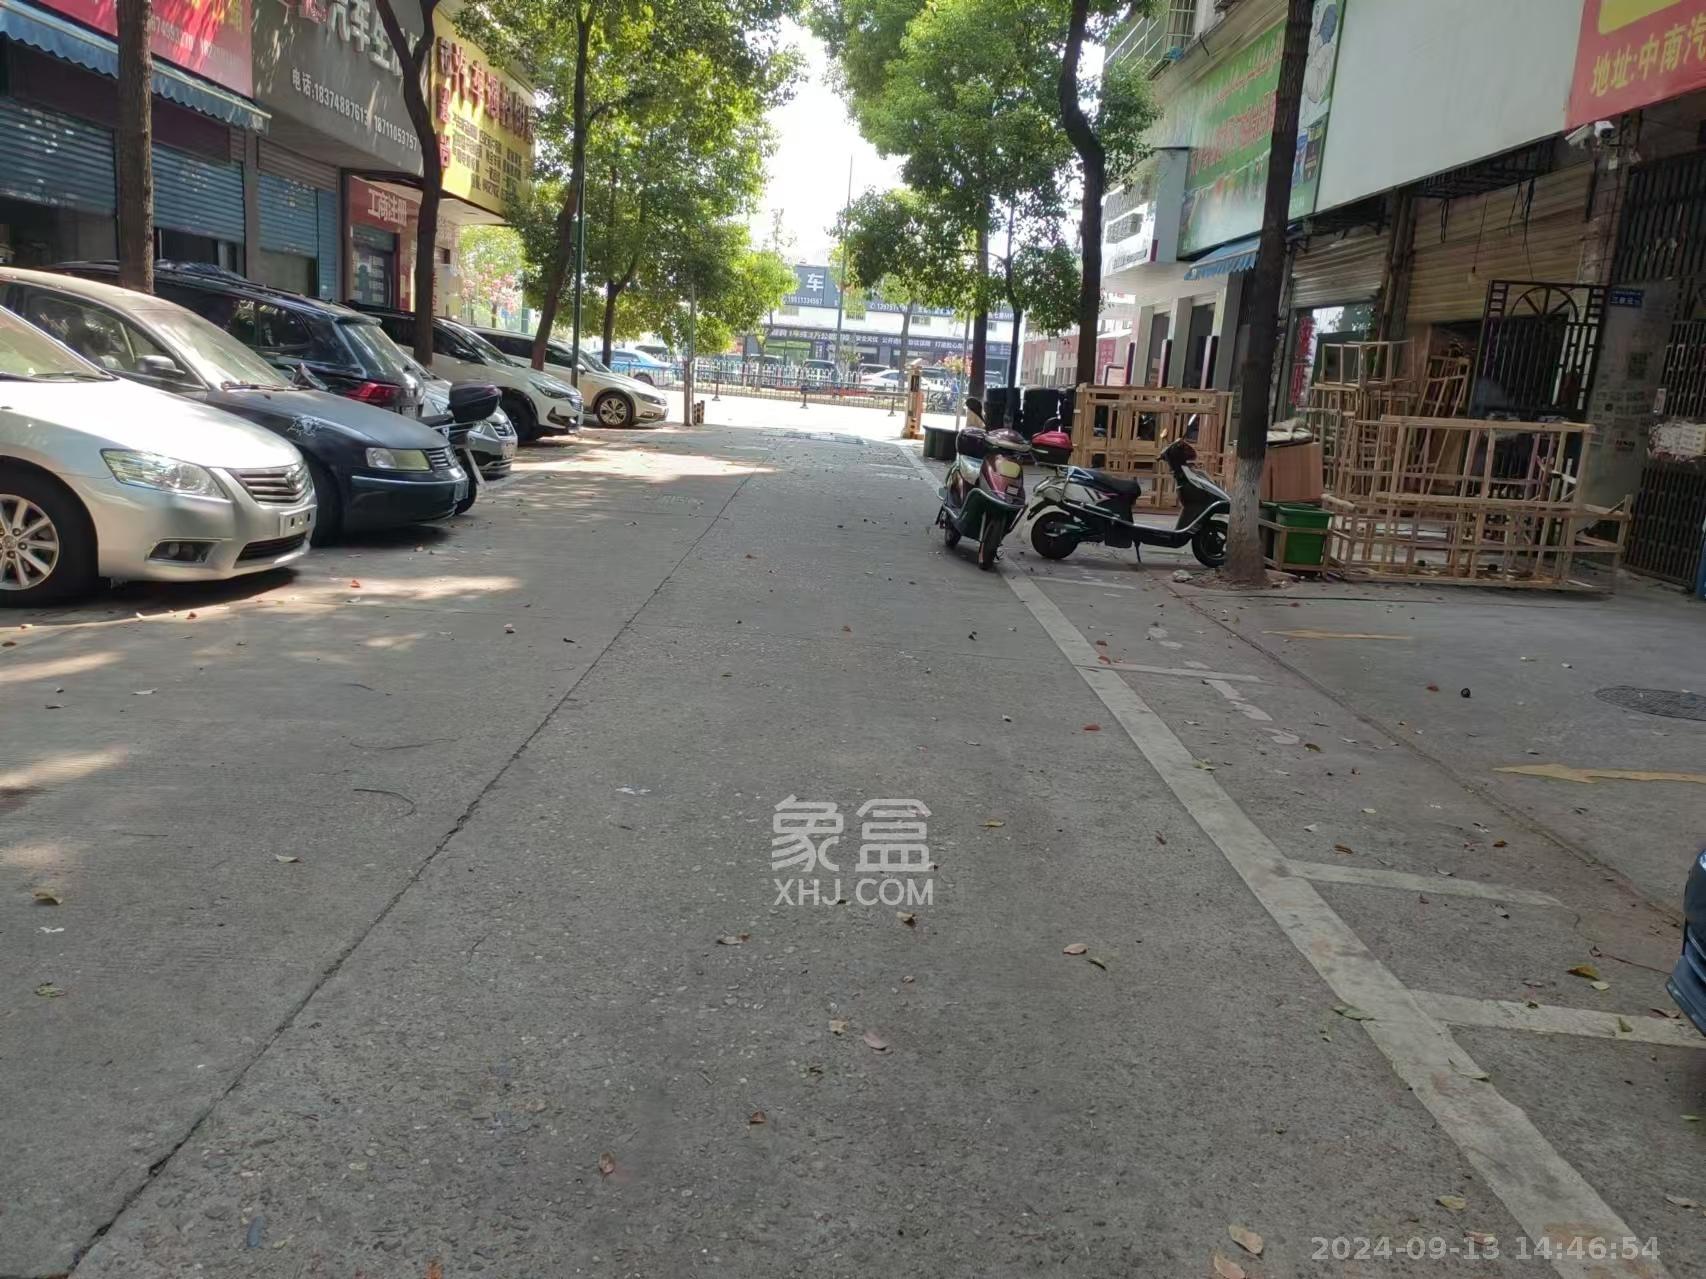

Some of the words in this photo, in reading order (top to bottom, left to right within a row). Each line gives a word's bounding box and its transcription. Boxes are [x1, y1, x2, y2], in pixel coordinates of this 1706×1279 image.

[368, 188, 407, 226] 工商注册
[806, 273, 824, 292] 车
